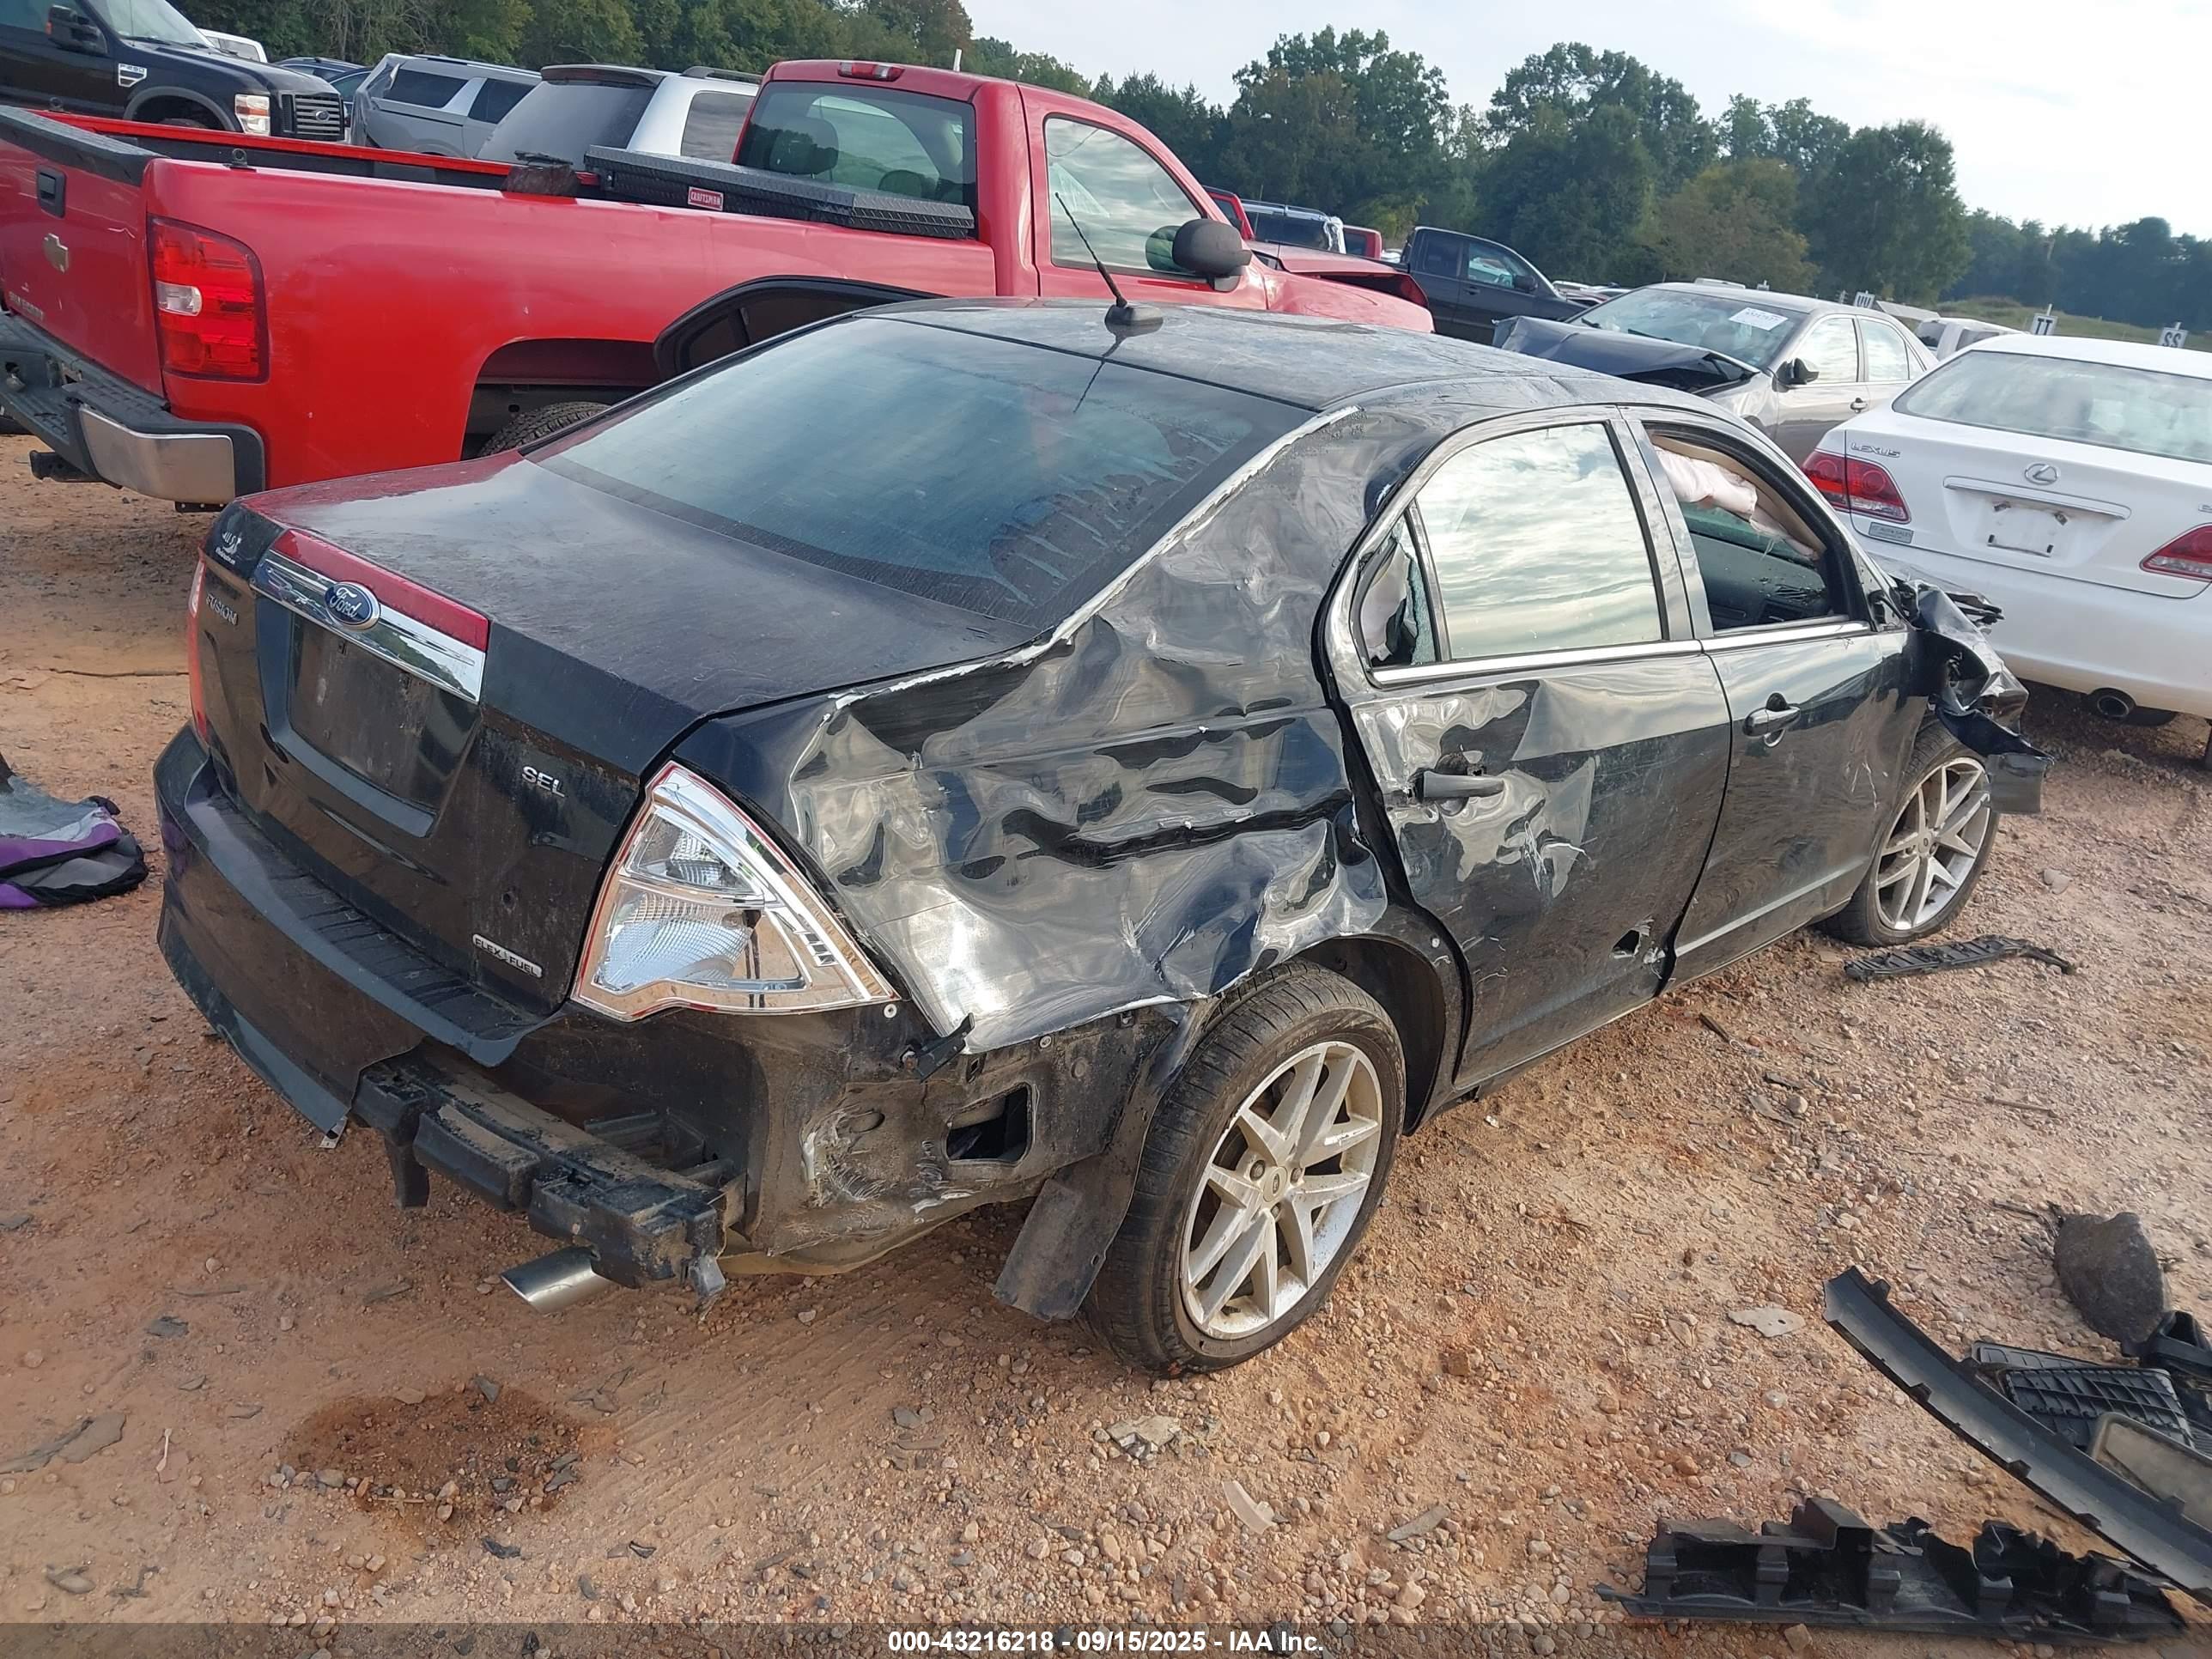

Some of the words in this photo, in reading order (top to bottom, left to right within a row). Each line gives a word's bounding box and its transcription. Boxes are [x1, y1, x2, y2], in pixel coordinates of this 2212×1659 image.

[690, 191, 721, 206] CRAFTSMAN
[2035, 318, 2053, 336] TT
[2162, 331, 2182, 348] SS
[1850, 441, 1901, 459] LEXUS
[206, 592, 239, 625] FUSION
[329, 586, 362, 617] Ford
[521, 766, 566, 799] SEL
[475, 938, 502, 958] FLEX
[509, 955, 538, 977] FUEL
